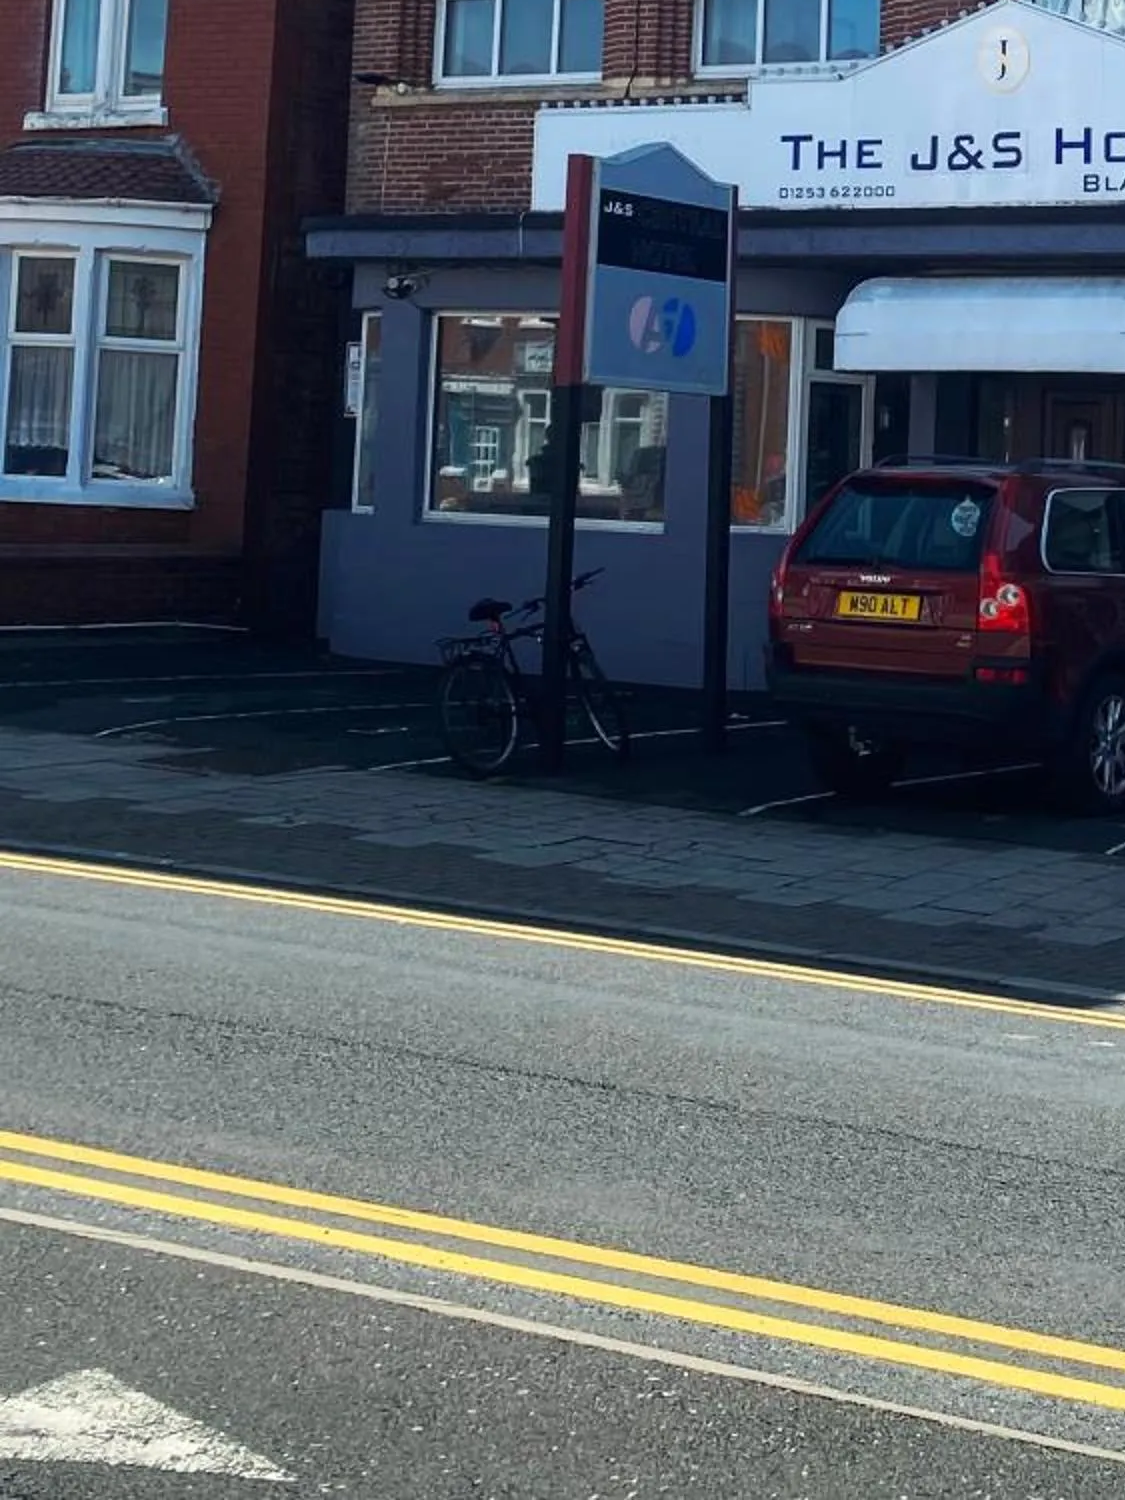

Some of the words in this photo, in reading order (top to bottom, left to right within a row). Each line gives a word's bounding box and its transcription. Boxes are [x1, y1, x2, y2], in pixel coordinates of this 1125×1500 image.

[780, 134, 883, 171] THE
[910, 131, 1022, 171] J&S
[779, 186, 826, 199] 01253
[829, 185, 895, 198] 622000
[603, 201, 633, 217] J&S
